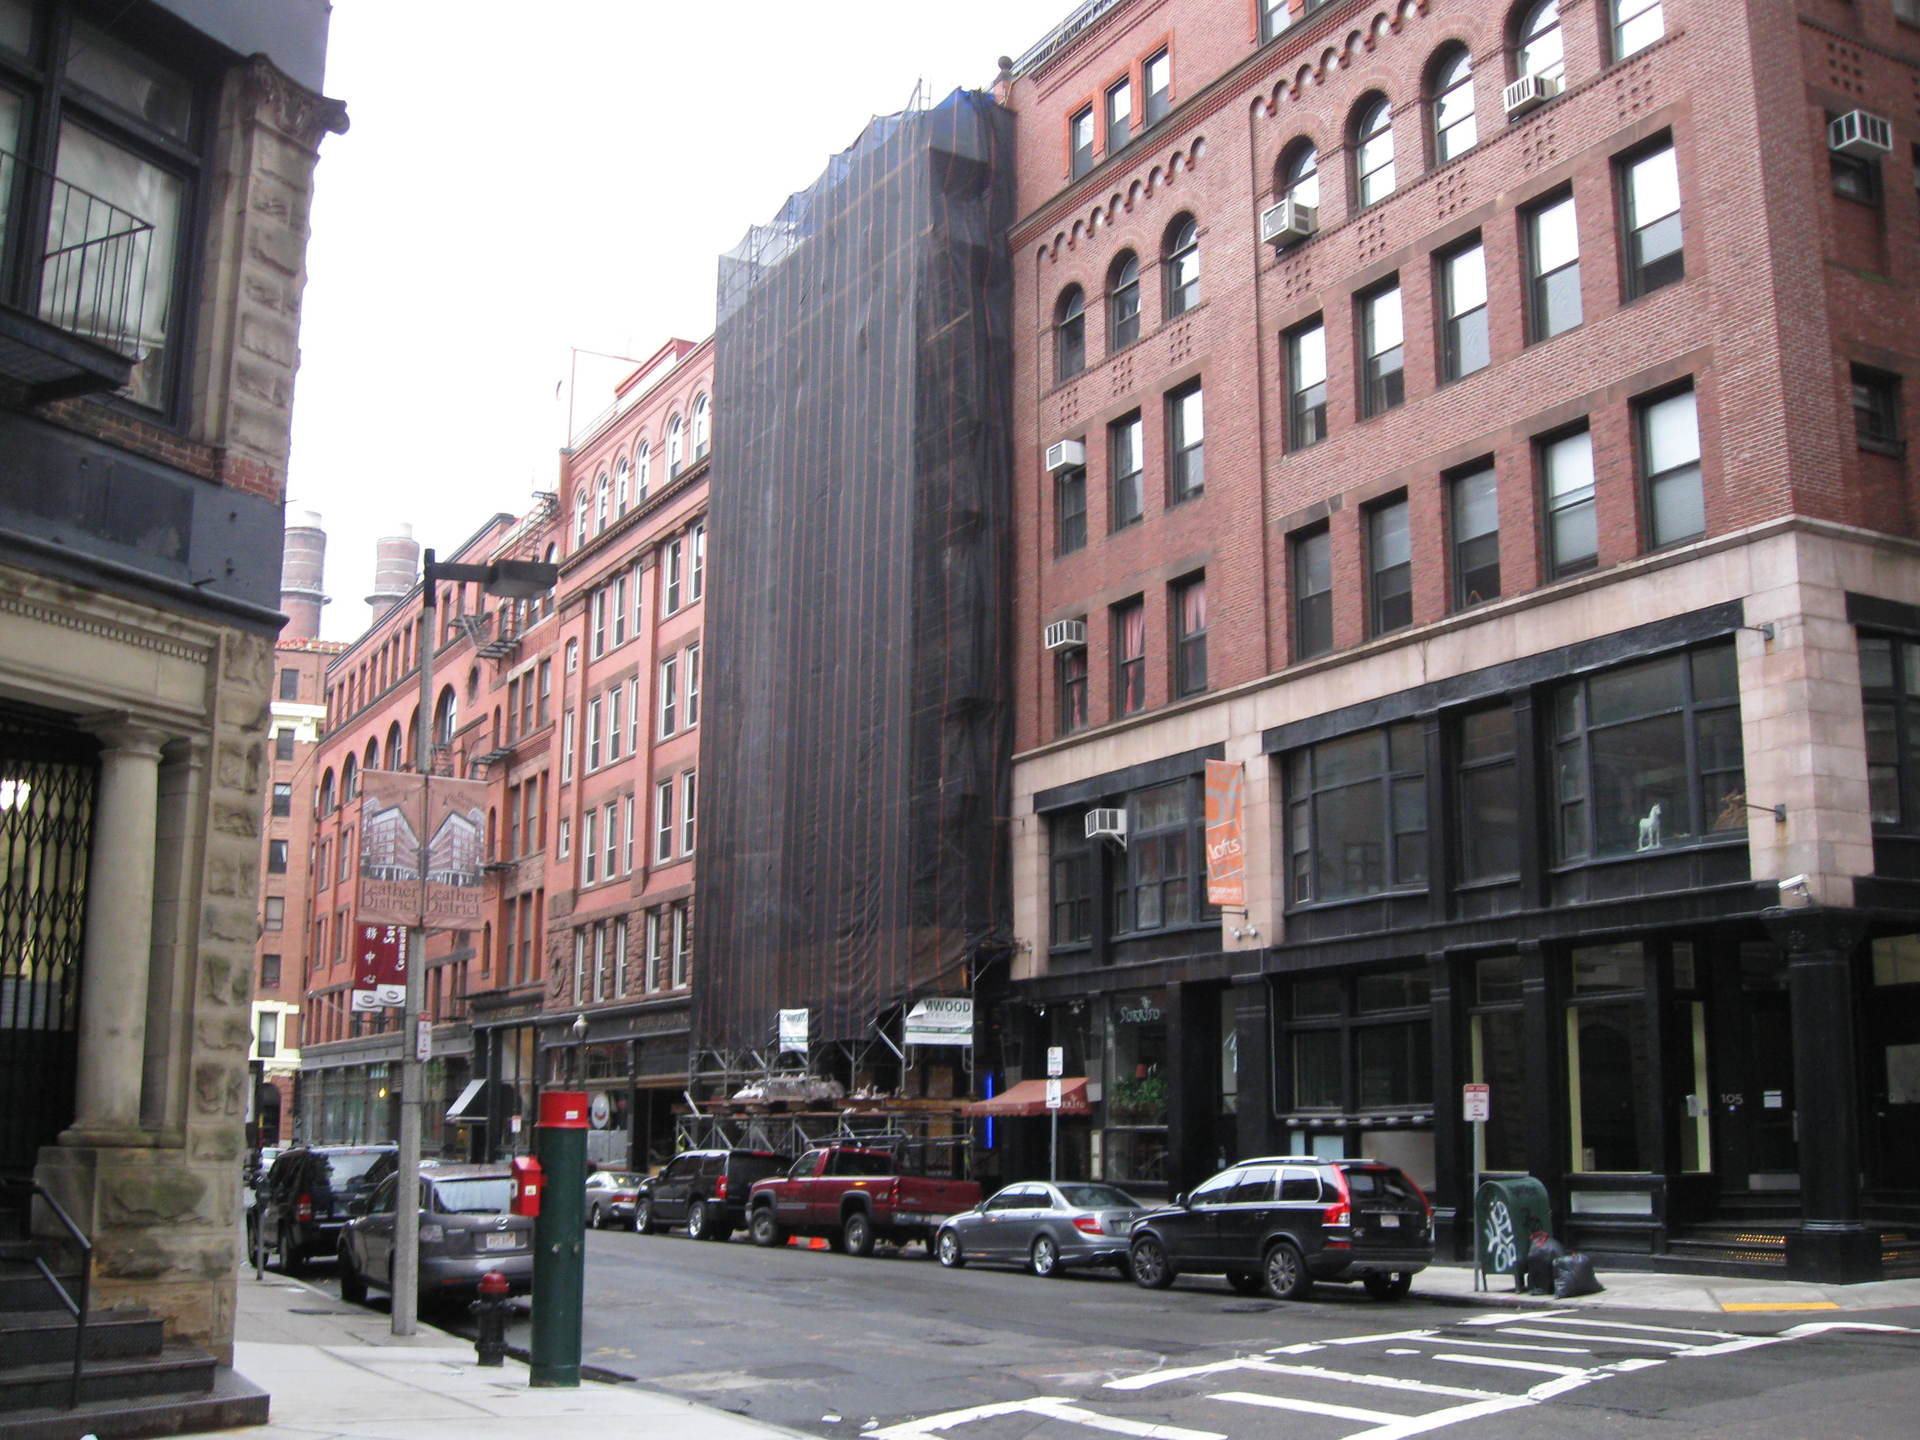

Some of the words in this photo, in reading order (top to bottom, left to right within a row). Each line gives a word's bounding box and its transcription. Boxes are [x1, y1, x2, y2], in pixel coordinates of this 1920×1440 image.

[362, 880, 418, 900] Leather
[426, 884, 480, 904] Leather
[360, 893, 418, 911] District
[426, 898, 480, 916] District
[1721, 1093, 1744, 1105] 105
